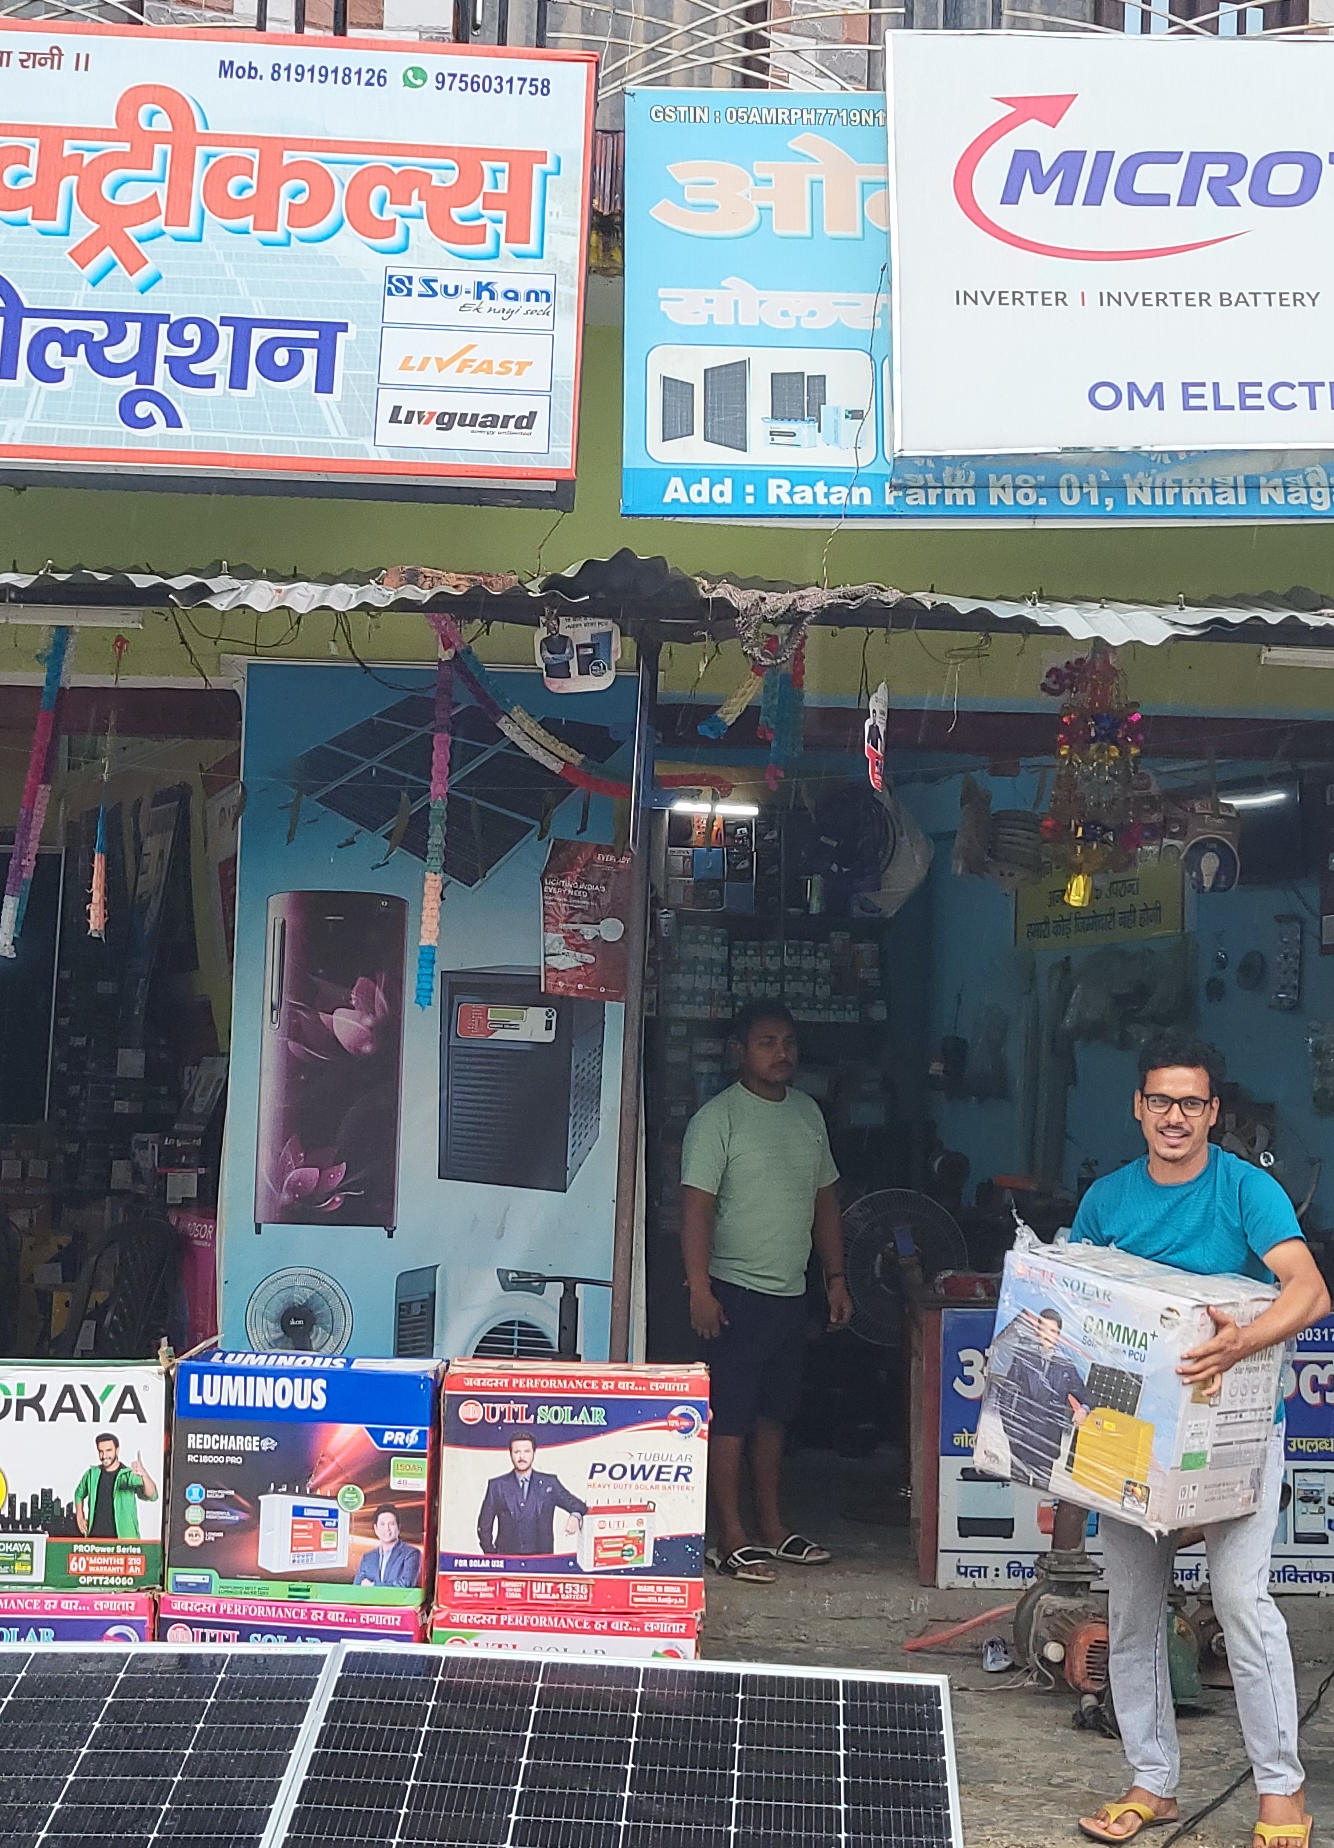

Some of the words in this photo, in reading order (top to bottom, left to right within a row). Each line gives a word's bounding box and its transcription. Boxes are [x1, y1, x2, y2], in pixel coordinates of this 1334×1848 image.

[18, 44, 65, 71] रानी
[217, 58, 264, 83] Mob.
[270, 62, 388, 89] 8191918126
[434, 70, 552, 98] 9756031758
[649, 104, 710, 124] GSTIN
[725, 106, 887, 128] 05AMRPH7719N1
[954, 288, 1070, 308] INVERTER
[1098, 289, 1213, 309] INVERTER
[1219, 289, 1321, 309] BATTERY
[397, 343, 534, 377] LIVFAST
[1086, 380, 1166, 412] OM
[662, 476, 733, 504] Add
[767, 477, 873, 506] Ratan
[210, 1351, 347, 1369] LUMINOUS
[1127, 1347, 1146, 1363] PCU
[188, 1373, 327, 1411] LUMINOUS
[511, 1377, 599, 1390] PERFORMANCE
[482, 1402, 535, 1425] UTL
[537, 1404, 608, 1427] SOLAR
[187, 1433, 260, 1452] REDCHARGE
[225, 1455, 243, 1465] PRO
[636, 1451, 693, 1463] TUBULAR
[587, 1462, 694, 1484] POWER
[587, 1482, 612, 1491] HEAVY
[613, 1483, 633, 1492] DUTY
[635, 1483, 660, 1492] SOLAR
[661, 1484, 696, 1493] BATTERY
[89, 1557, 125, 1566] MONTHS
[219, 1602, 308, 1620] PERFORMANCE
[499, 1613, 591, 1631] PERFORMANCE
